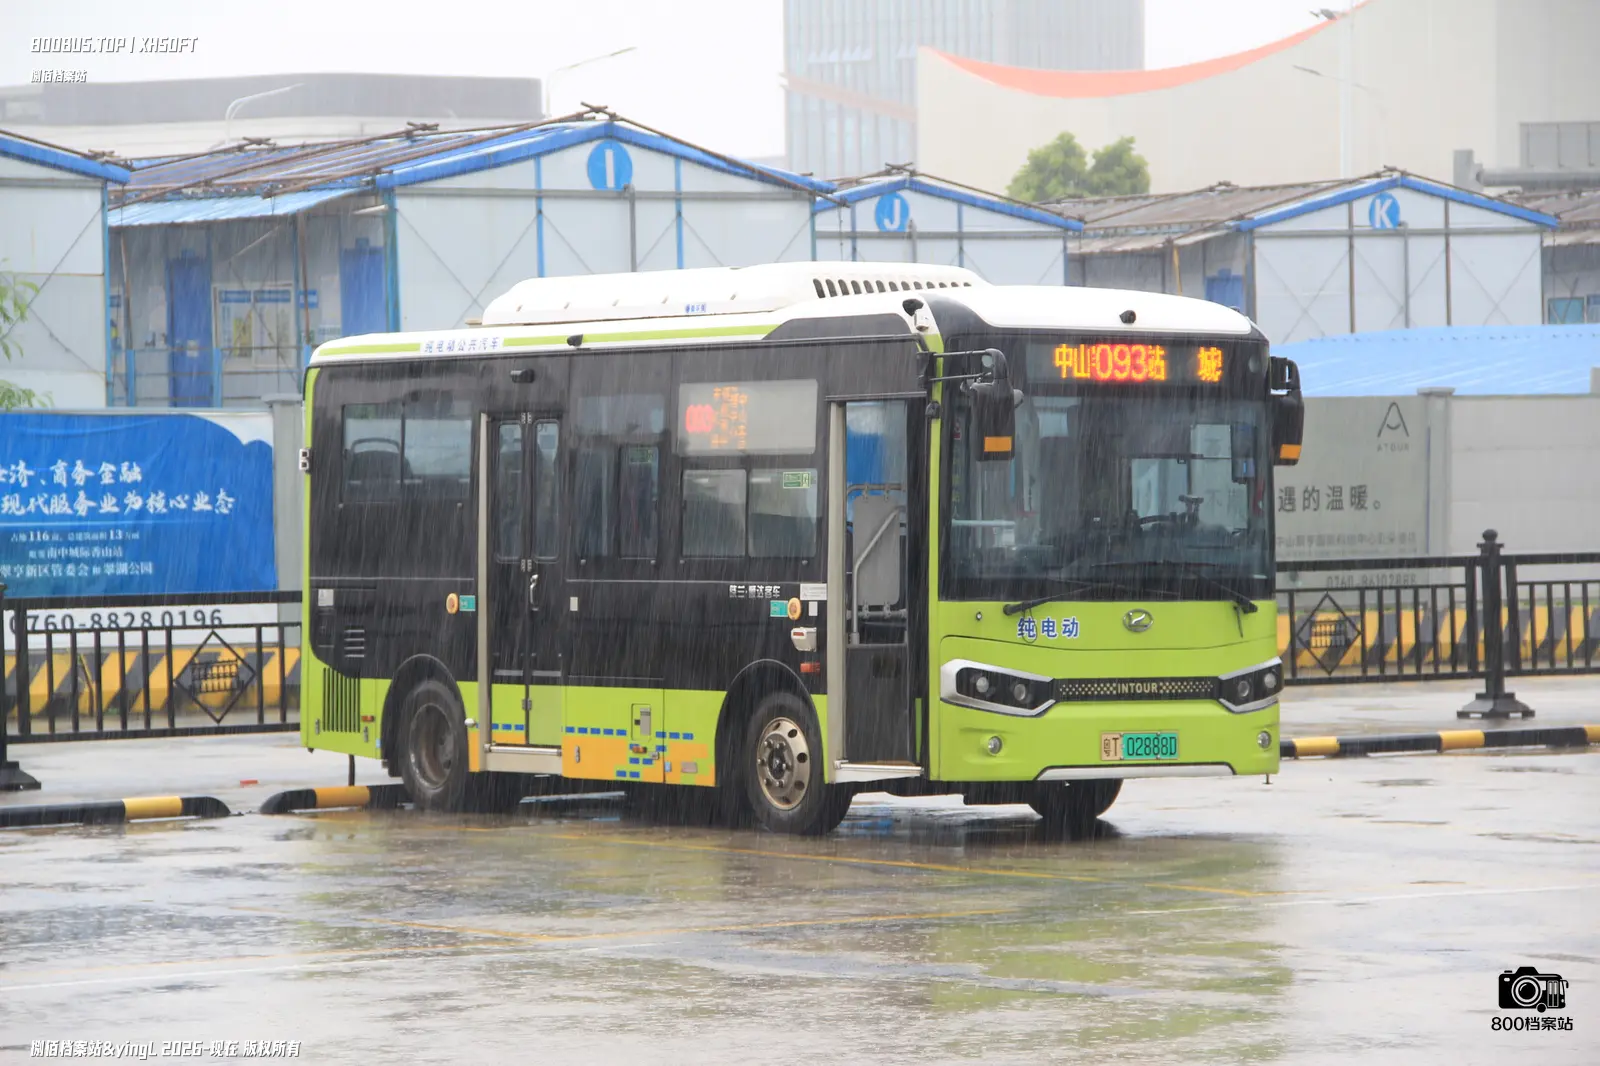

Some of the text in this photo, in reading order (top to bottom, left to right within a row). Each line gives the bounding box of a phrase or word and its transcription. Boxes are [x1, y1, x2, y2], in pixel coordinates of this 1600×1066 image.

[883, 199, 901, 231] J
[1374, 197, 1392, 228] K
[1016, 616, 1081, 639] 纯电动
[1117, 682, 1158, 694] INTOUR
